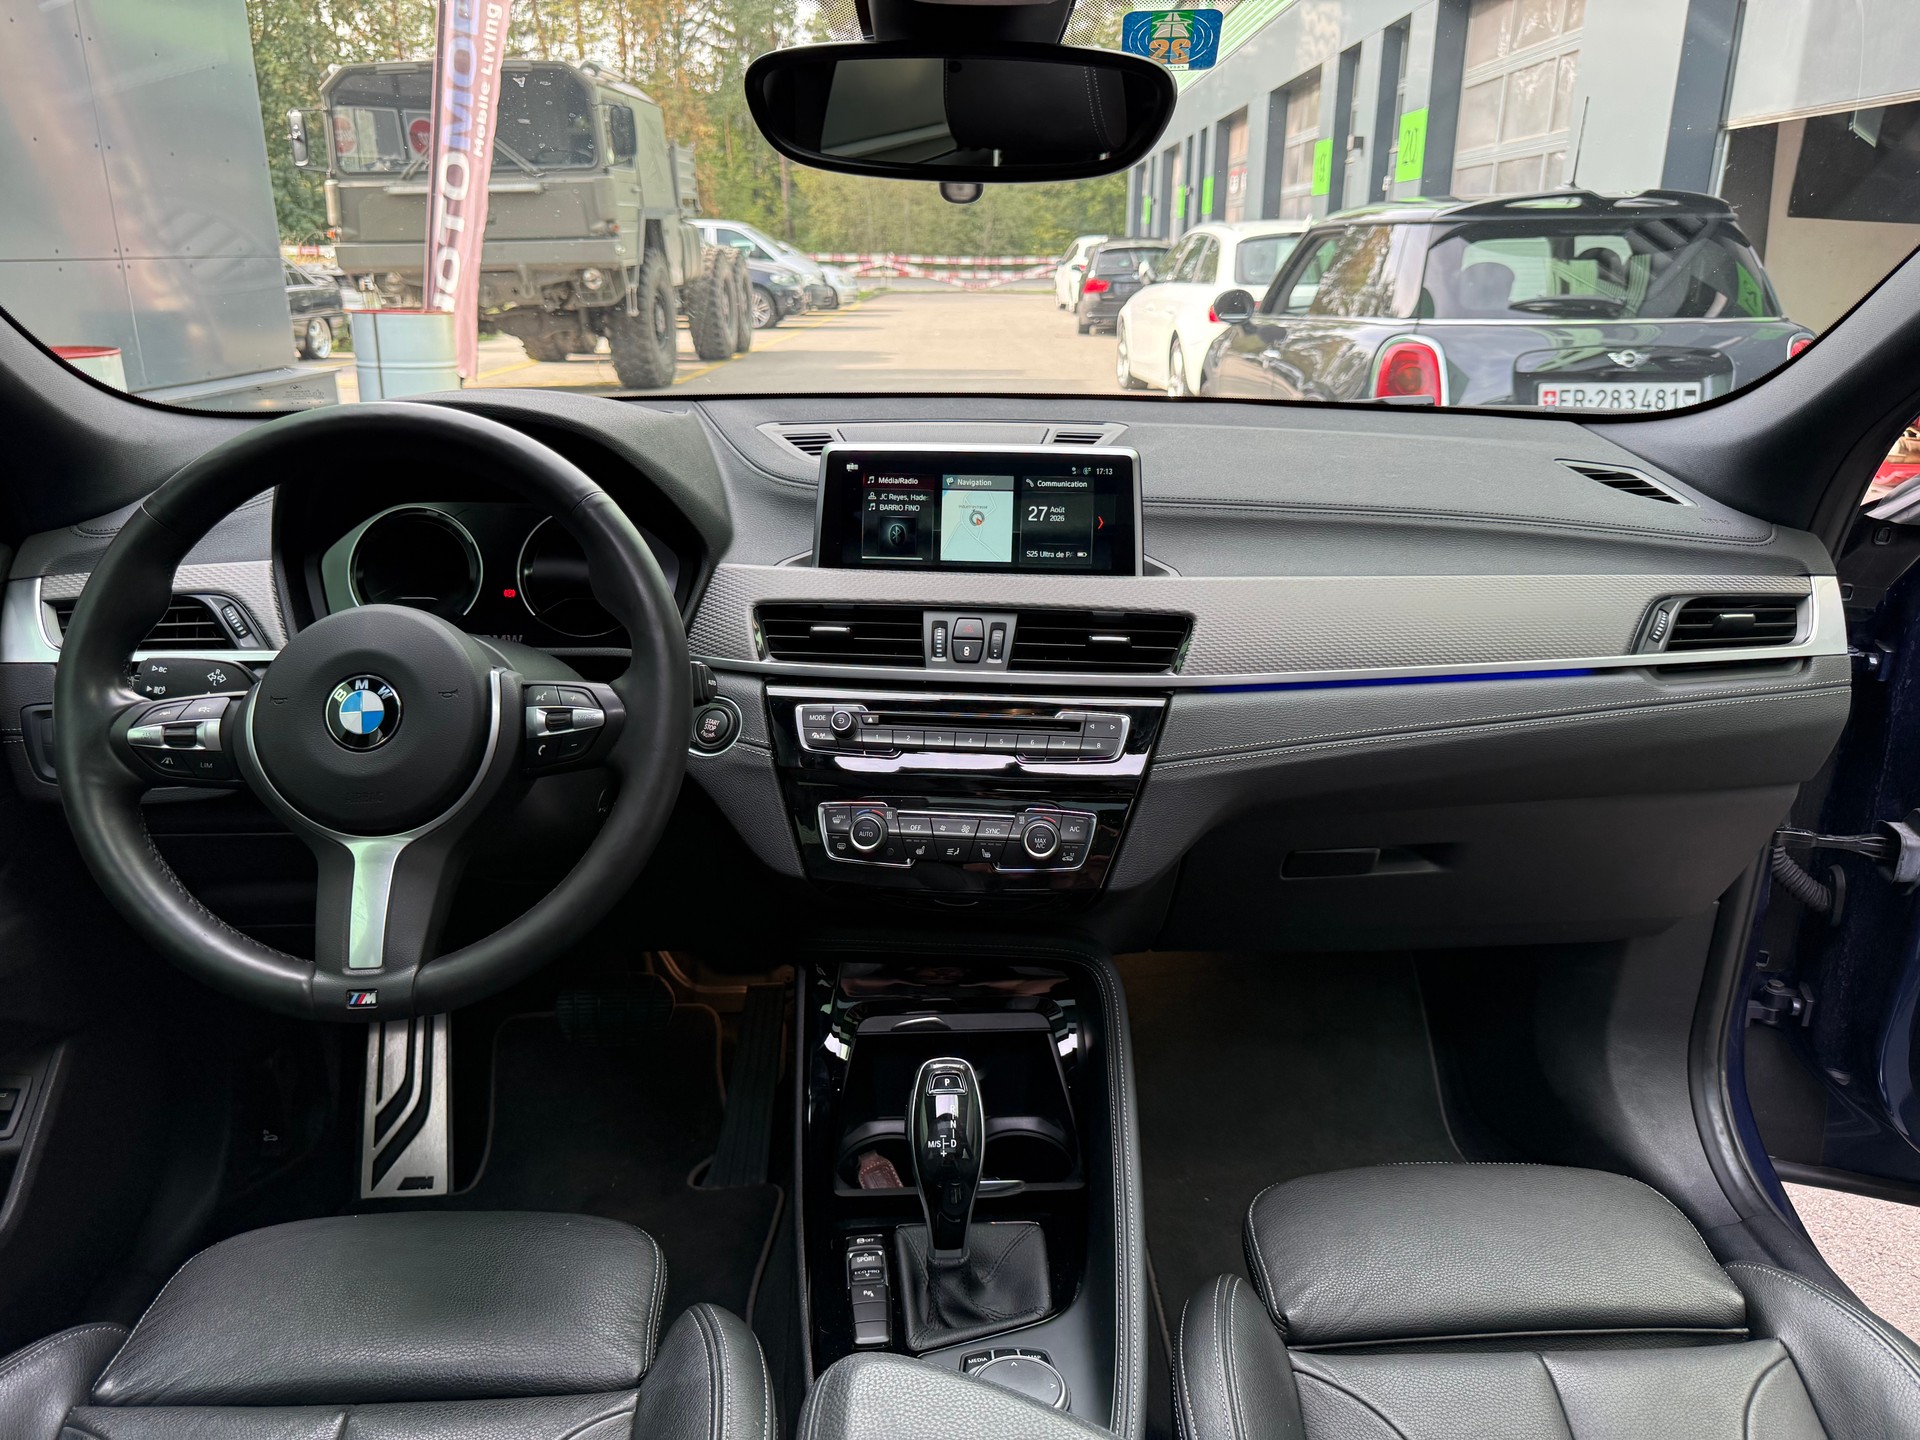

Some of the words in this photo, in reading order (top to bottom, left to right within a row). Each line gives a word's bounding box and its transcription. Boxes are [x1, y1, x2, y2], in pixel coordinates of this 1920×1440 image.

[480, 2, 504, 76] Living
[473, 80, 491, 158] Mobile
[1402, 128, 1418, 166] 20
[878, 476, 919, 485] Média/Radio
[957, 479, 992, 487] Navigation
[1037, 480, 1088, 488] Communication
[888, 493, 909, 502] Reyes,
[904, 504, 920, 512] FINO
[1028, 505, 1048, 522] 27
[1050, 506, 1066, 514] Août
[1049, 514, 1066, 522] 2026
[1026, 550, 1039, 558] S25
[1055, 551, 1065, 559] de
[333, 679, 394, 702] BMW
[705, 717, 720, 726] START
[704, 723, 717, 731] STOP
[858, 830, 874, 838] AUTO
[985, 827, 1001, 835] SYNC
[944, 1078, 950, 1087] P
[950, 1104, 956, 1113] R
[950, 1120, 956, 1129] N
[928, 1140, 941, 1148] M/S
[950, 1140, 957, 1148] D
